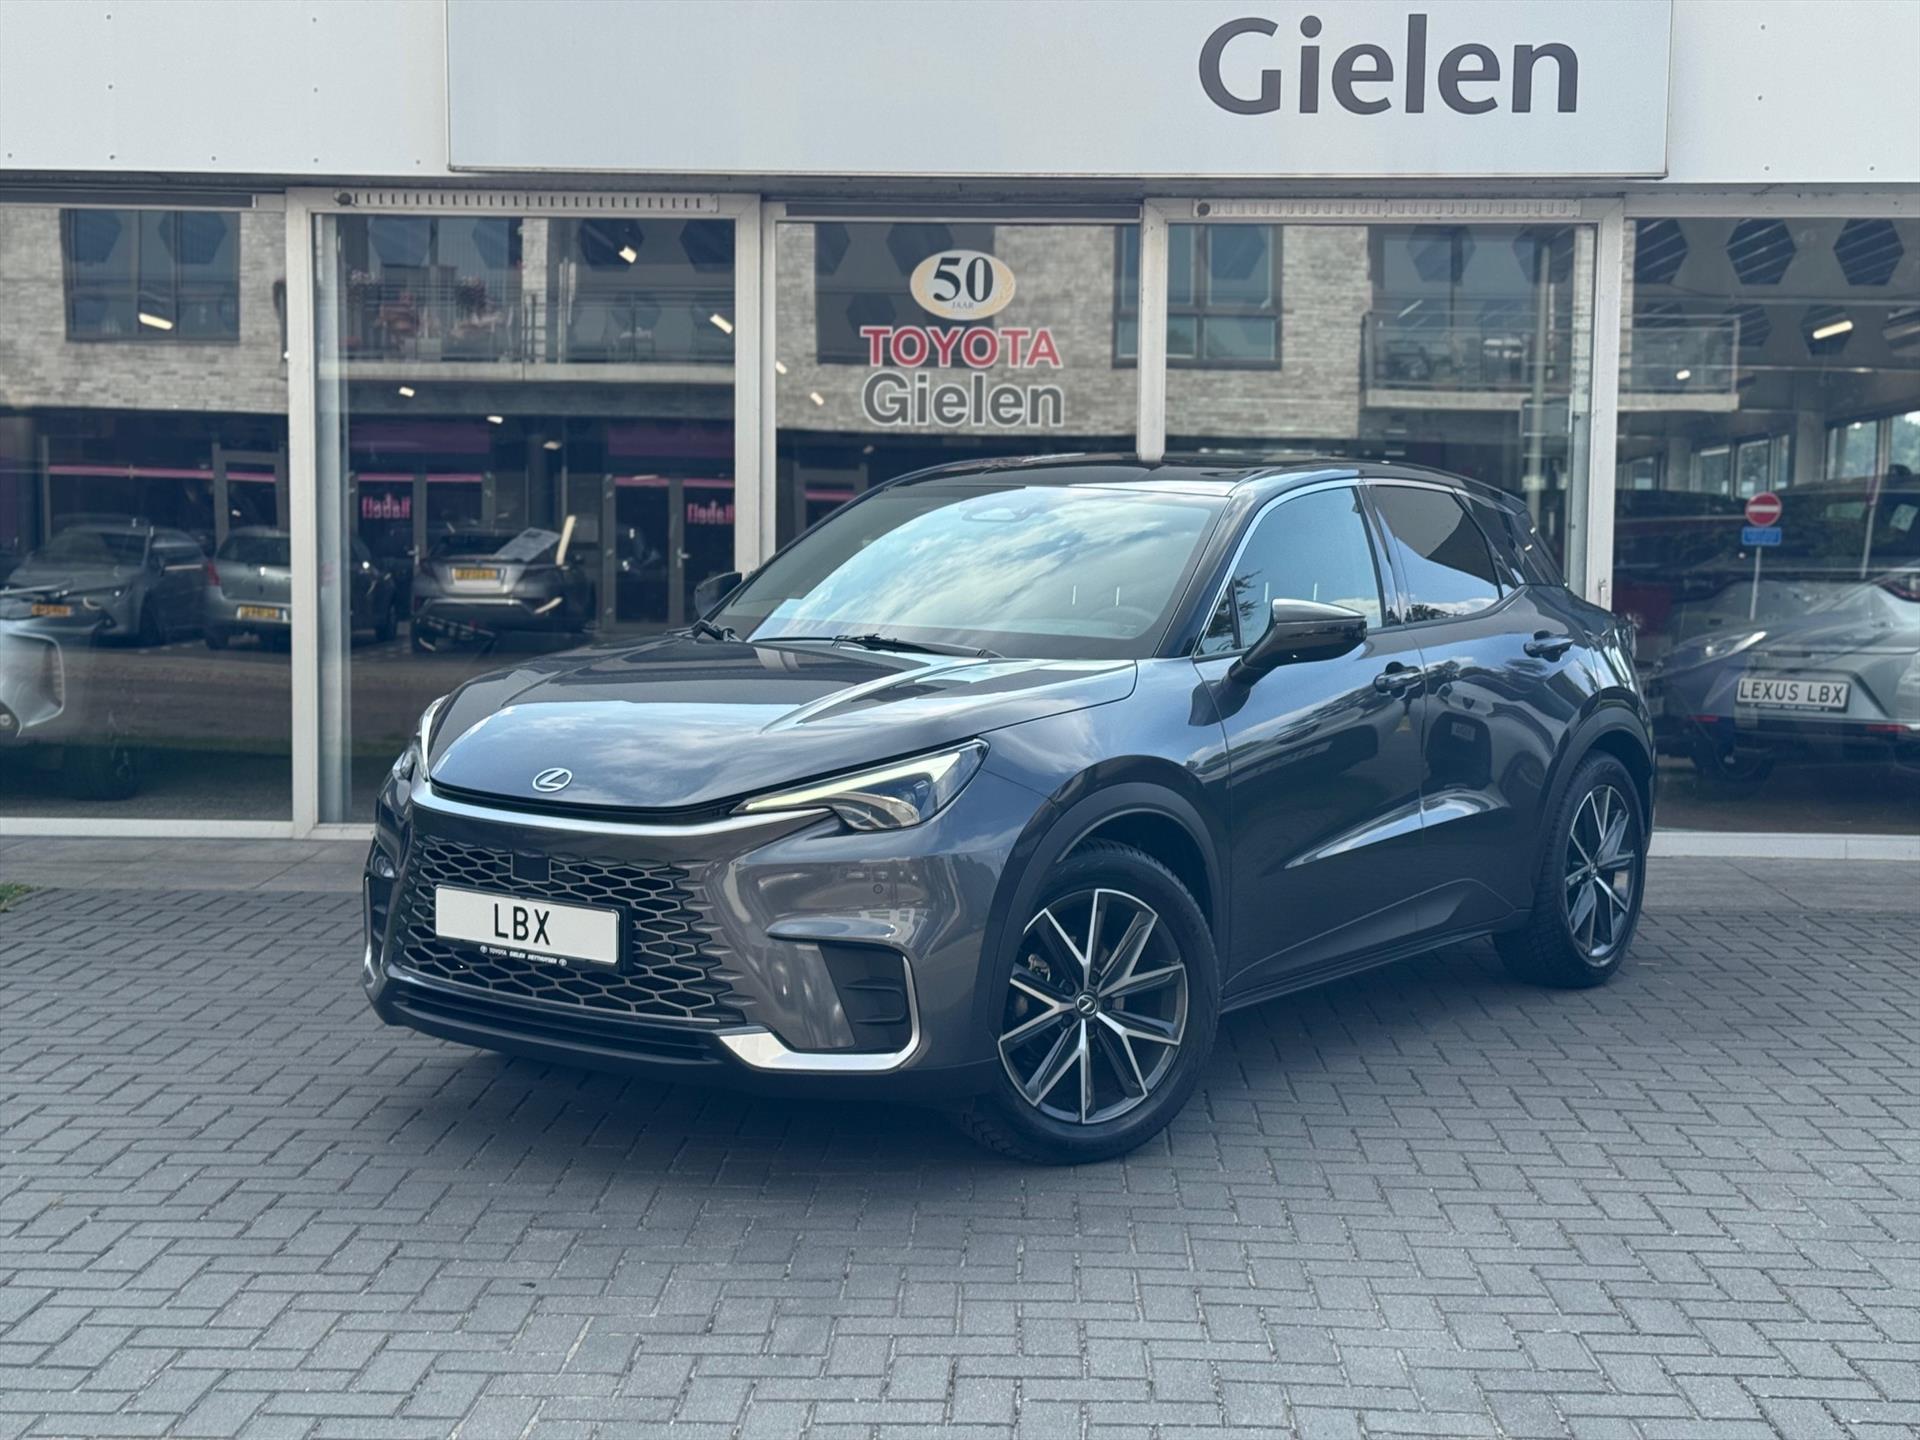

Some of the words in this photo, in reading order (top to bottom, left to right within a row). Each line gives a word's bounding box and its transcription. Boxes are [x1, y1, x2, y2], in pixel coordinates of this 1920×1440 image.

[1198, 13, 1579, 115] Gielen
[933, 256, 994, 303] 50
[951, 301, 974, 310] JAAR
[860, 326, 1062, 368] TOYOTA
[863, 370, 1064, 427] Gielen
[1740, 681, 1799, 701] LEXUS
[1807, 684, 1844, 704] LBX
[494, 903, 550, 946] LBX
